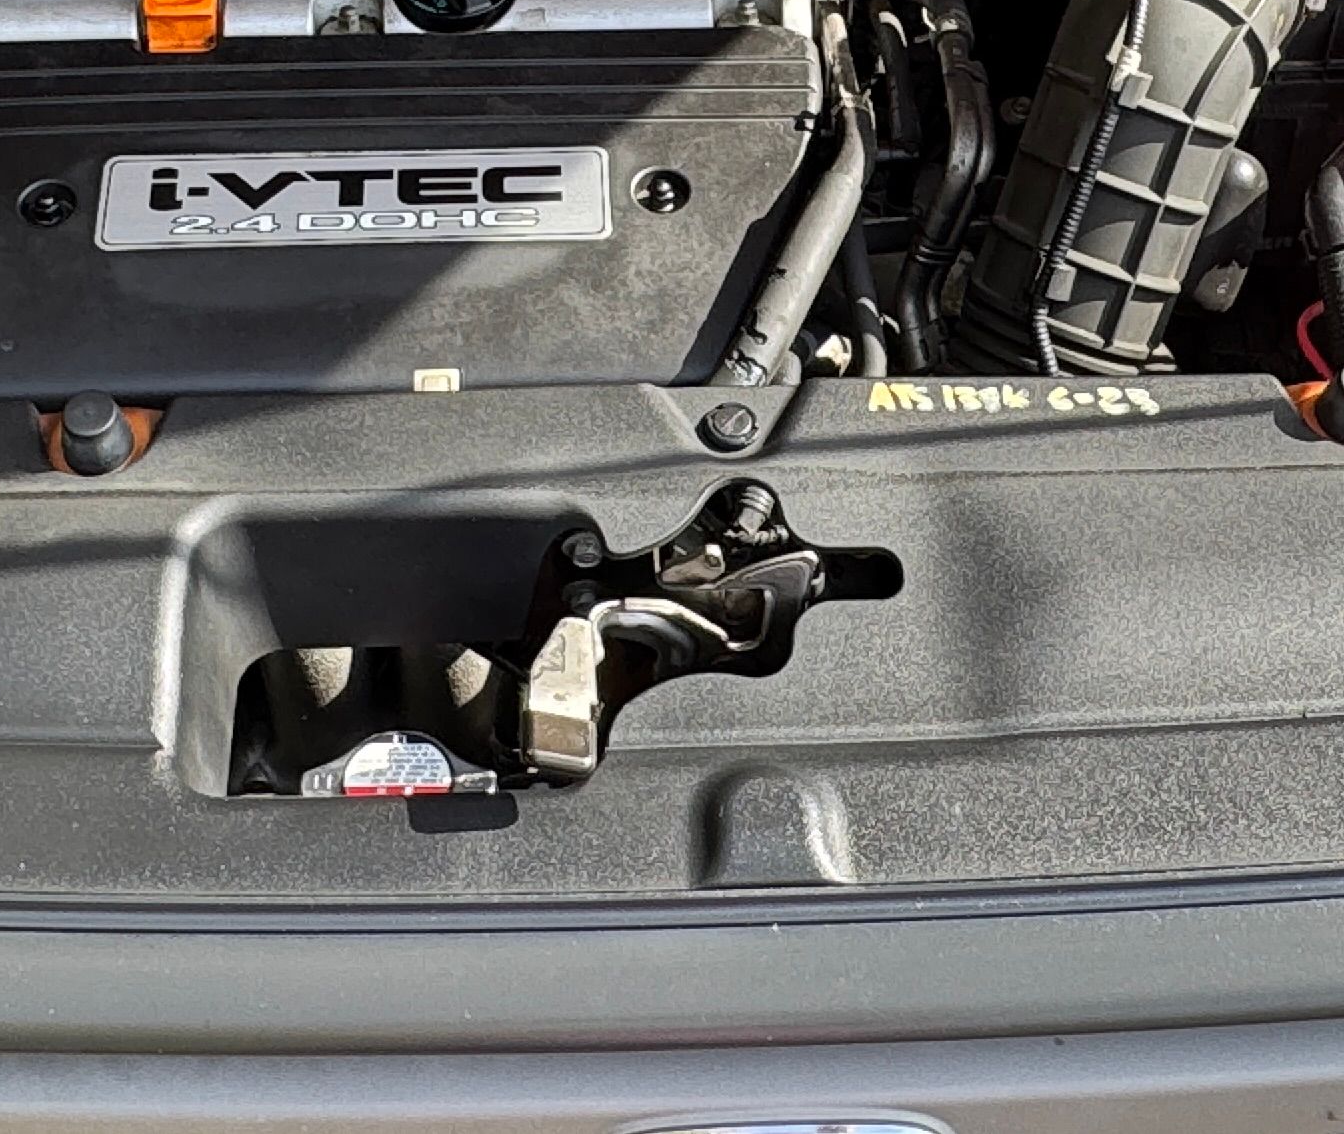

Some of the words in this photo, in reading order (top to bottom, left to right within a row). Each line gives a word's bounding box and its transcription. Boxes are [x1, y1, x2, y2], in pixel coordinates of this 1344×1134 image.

[149, 165, 562, 211] i-VTEC
[168, 212, 282, 235] 2.4
[296, 207, 540, 232] DOHC
[868, 382, 934, 412] ATS
